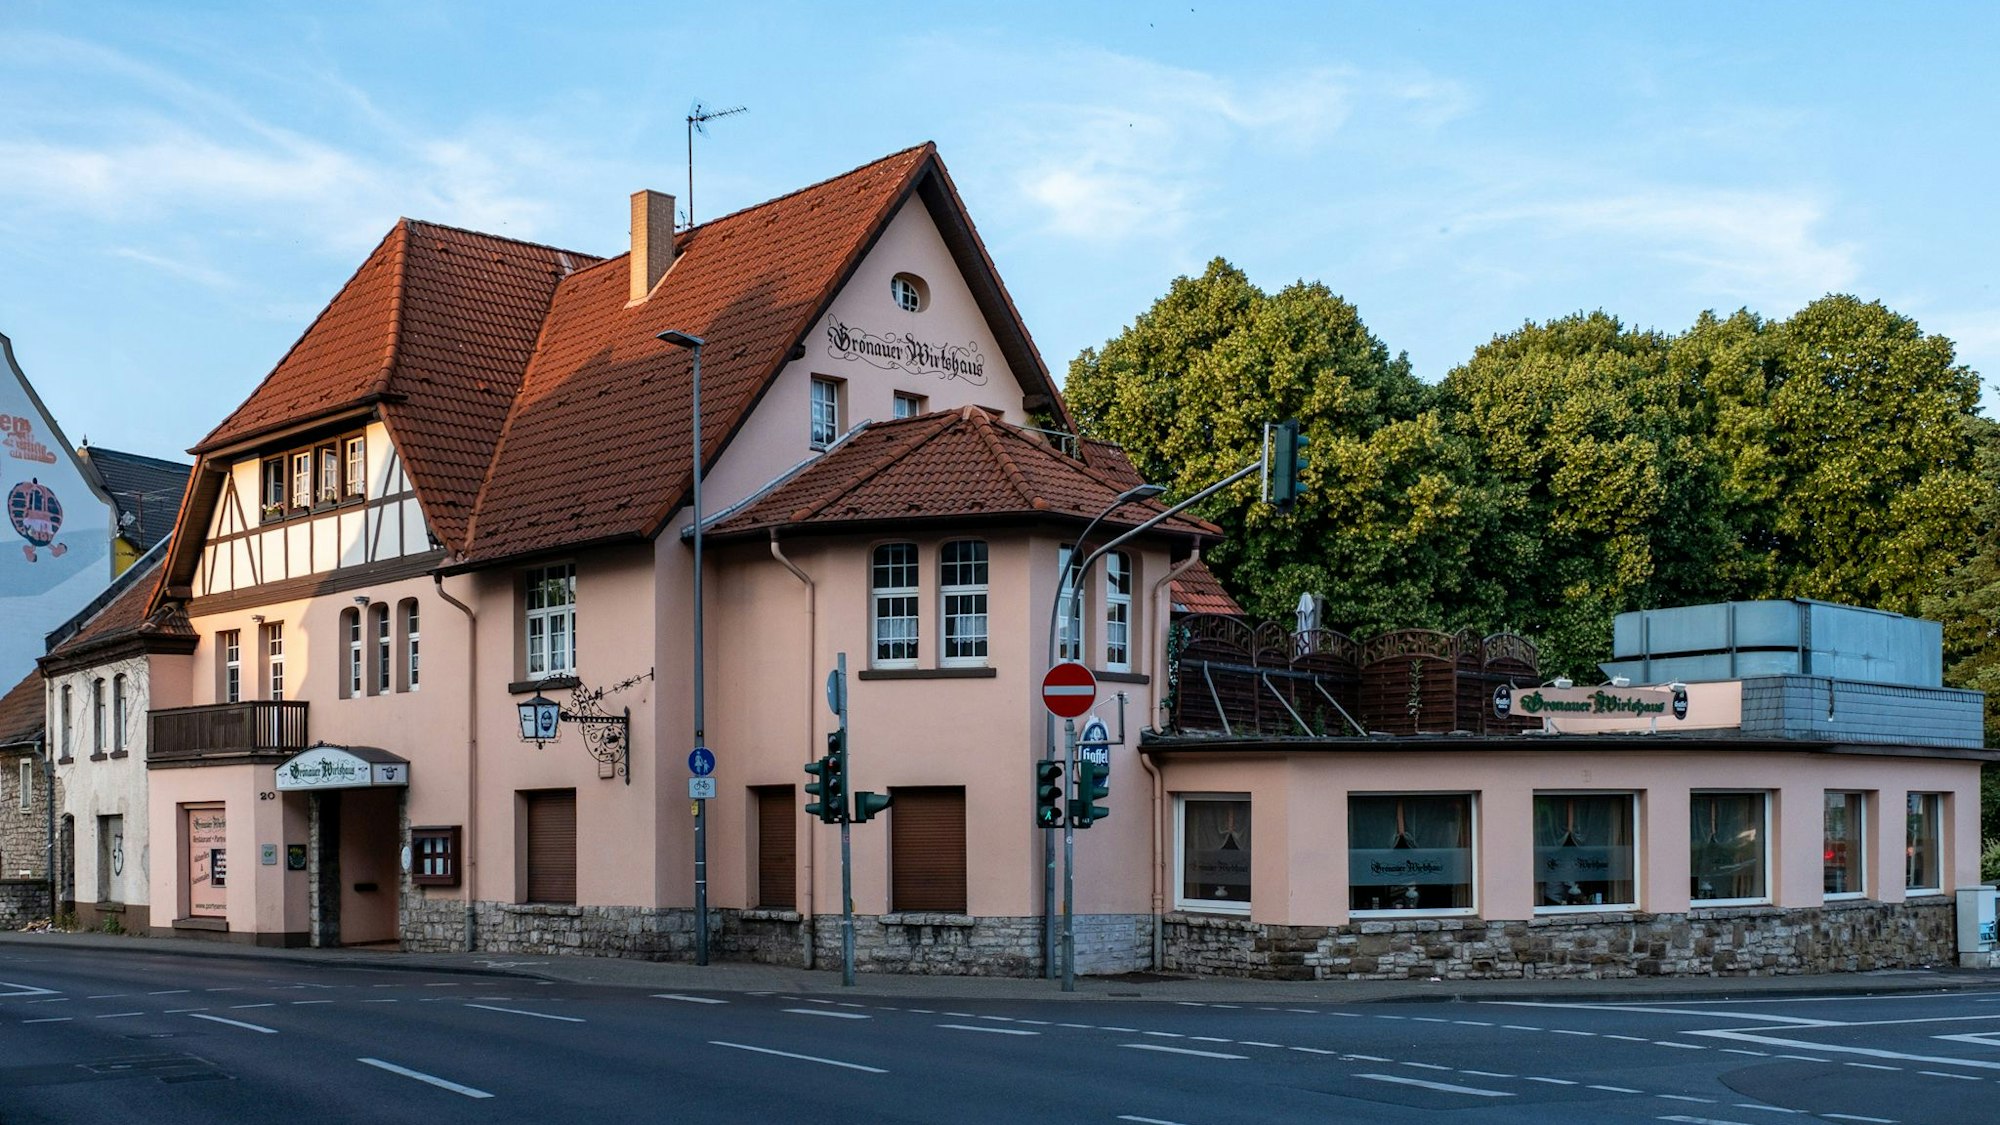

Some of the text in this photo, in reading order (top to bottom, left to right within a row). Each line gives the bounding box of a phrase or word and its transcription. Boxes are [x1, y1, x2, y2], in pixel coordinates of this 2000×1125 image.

[827, 322, 984, 379] Gronauer Wirtshaus
[1520, 690, 1665, 717] Gronauer Wirtshaus
[1083, 747, 1109, 765] Gaffel
[290, 757, 355, 780] Gronauer Wirtshaus
[260, 791, 275, 800] 20
